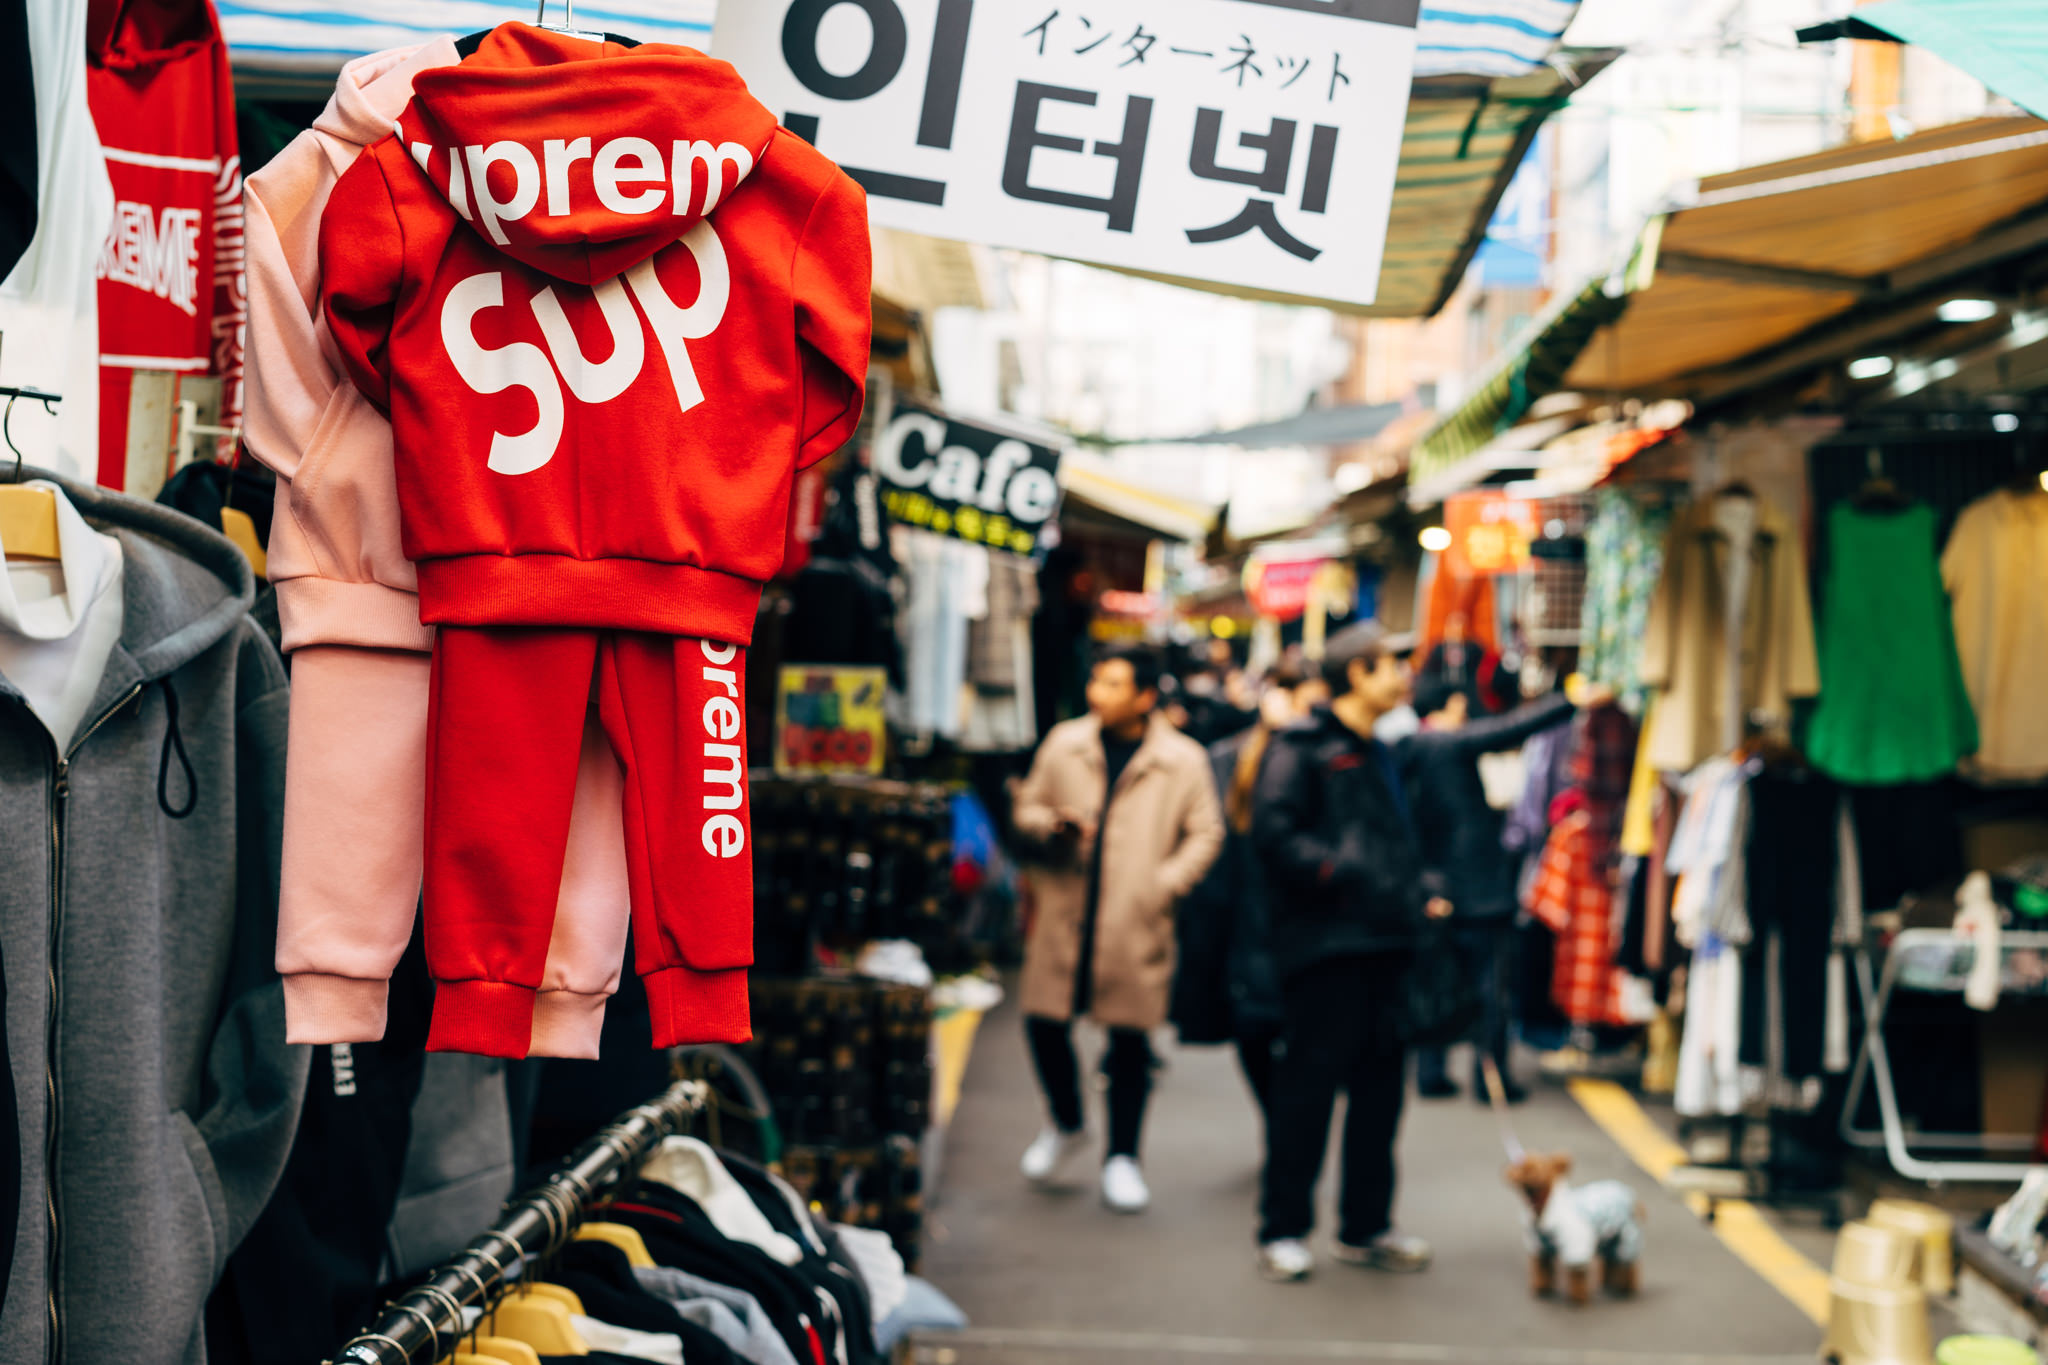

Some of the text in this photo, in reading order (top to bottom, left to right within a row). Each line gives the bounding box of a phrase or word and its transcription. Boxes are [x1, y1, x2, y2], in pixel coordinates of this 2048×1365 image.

[1022, 8, 1351, 102] インターネット
[395, 120, 770, 245] uprem
[782, 0, 1340, 262] 인터넷
[876, 412, 1058, 523] Cafe
